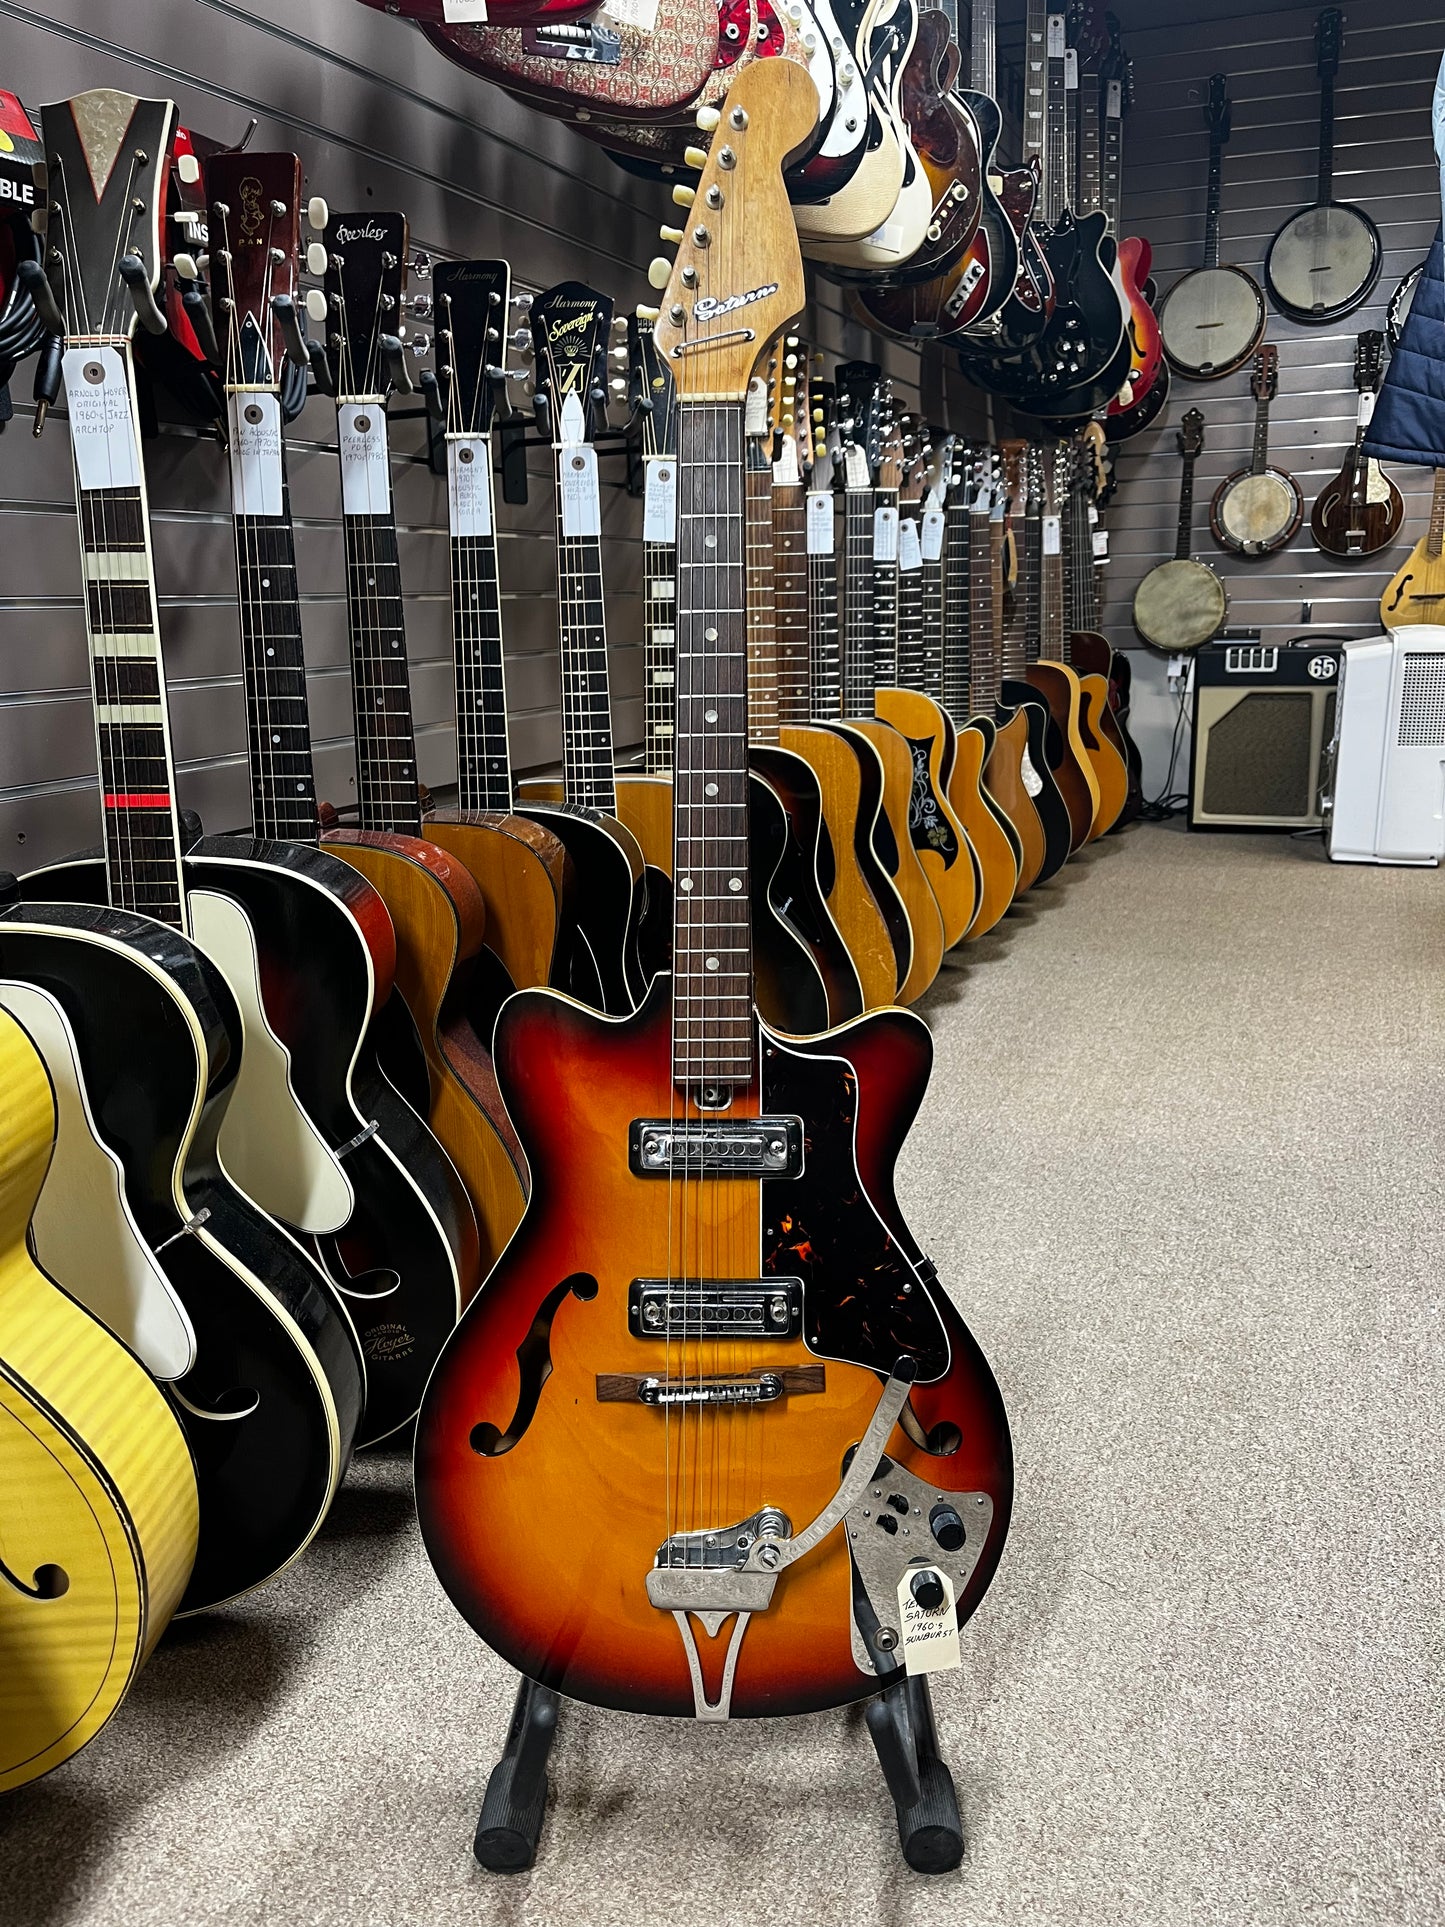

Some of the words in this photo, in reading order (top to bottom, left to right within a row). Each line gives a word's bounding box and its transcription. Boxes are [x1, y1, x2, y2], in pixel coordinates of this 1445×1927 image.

[0, 177, 35, 205] BLE
[188, 221, 209, 242] INS
[336, 219, 389, 245] Peerless
[238, 238, 263, 247] PAN
[447, 267, 498, 283] Harmony
[544, 294, 598, 312] Harmony
[692, 282, 779, 322] Saturn
[549, 311, 594, 342] Sovereign
[69, 389, 100, 398] ARNOLD
[104, 386, 127, 396] HOYER
[76, 400, 118, 408] ORIGINAL
[107, 409, 129, 420] JAZZ
[75, 424, 115, 434] ARCHTOP
[1309, 657, 1335, 679] 65
[364, 1323, 408, 1337] ORIGINAL
[363, 1333, 416, 1356] Hoyer
[371, 1347, 414, 1361] GITARRE
[904, 1604, 951, 1623] SATURN
[905, 1628, 955, 1646] SUNBURST
